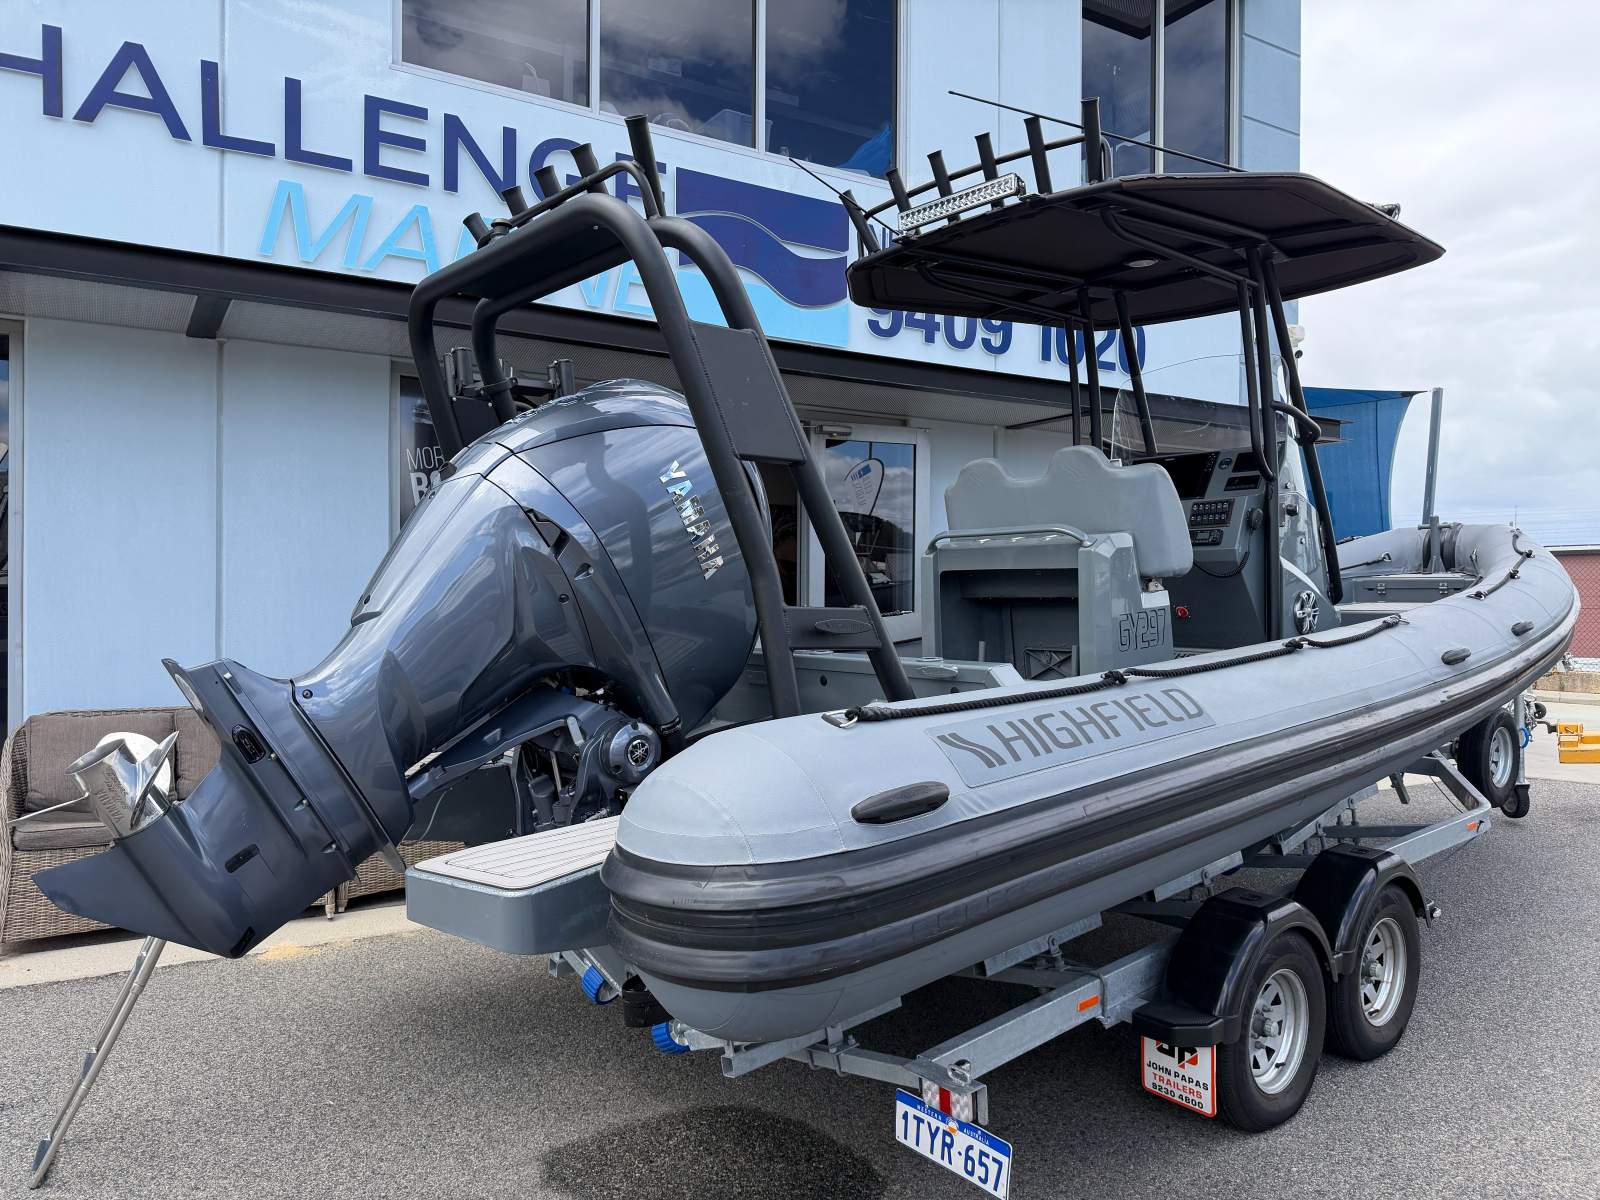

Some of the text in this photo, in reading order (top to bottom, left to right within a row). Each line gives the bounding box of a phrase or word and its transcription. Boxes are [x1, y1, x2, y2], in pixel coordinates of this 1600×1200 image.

[659, 460, 724, 581] YAMAHA
[1119, 608, 1166, 653] GY297
[986, 688, 1205, 763] HIGHFIELD
[1146, 1060, 1209, 1091] JOHN PAPAS
[1151, 1082, 1204, 1109] 9230 4800
[1152, 1071, 1203, 1099] TRAILERS
[916, 1105, 989, 1146] WESTERN AUSTRALIA
